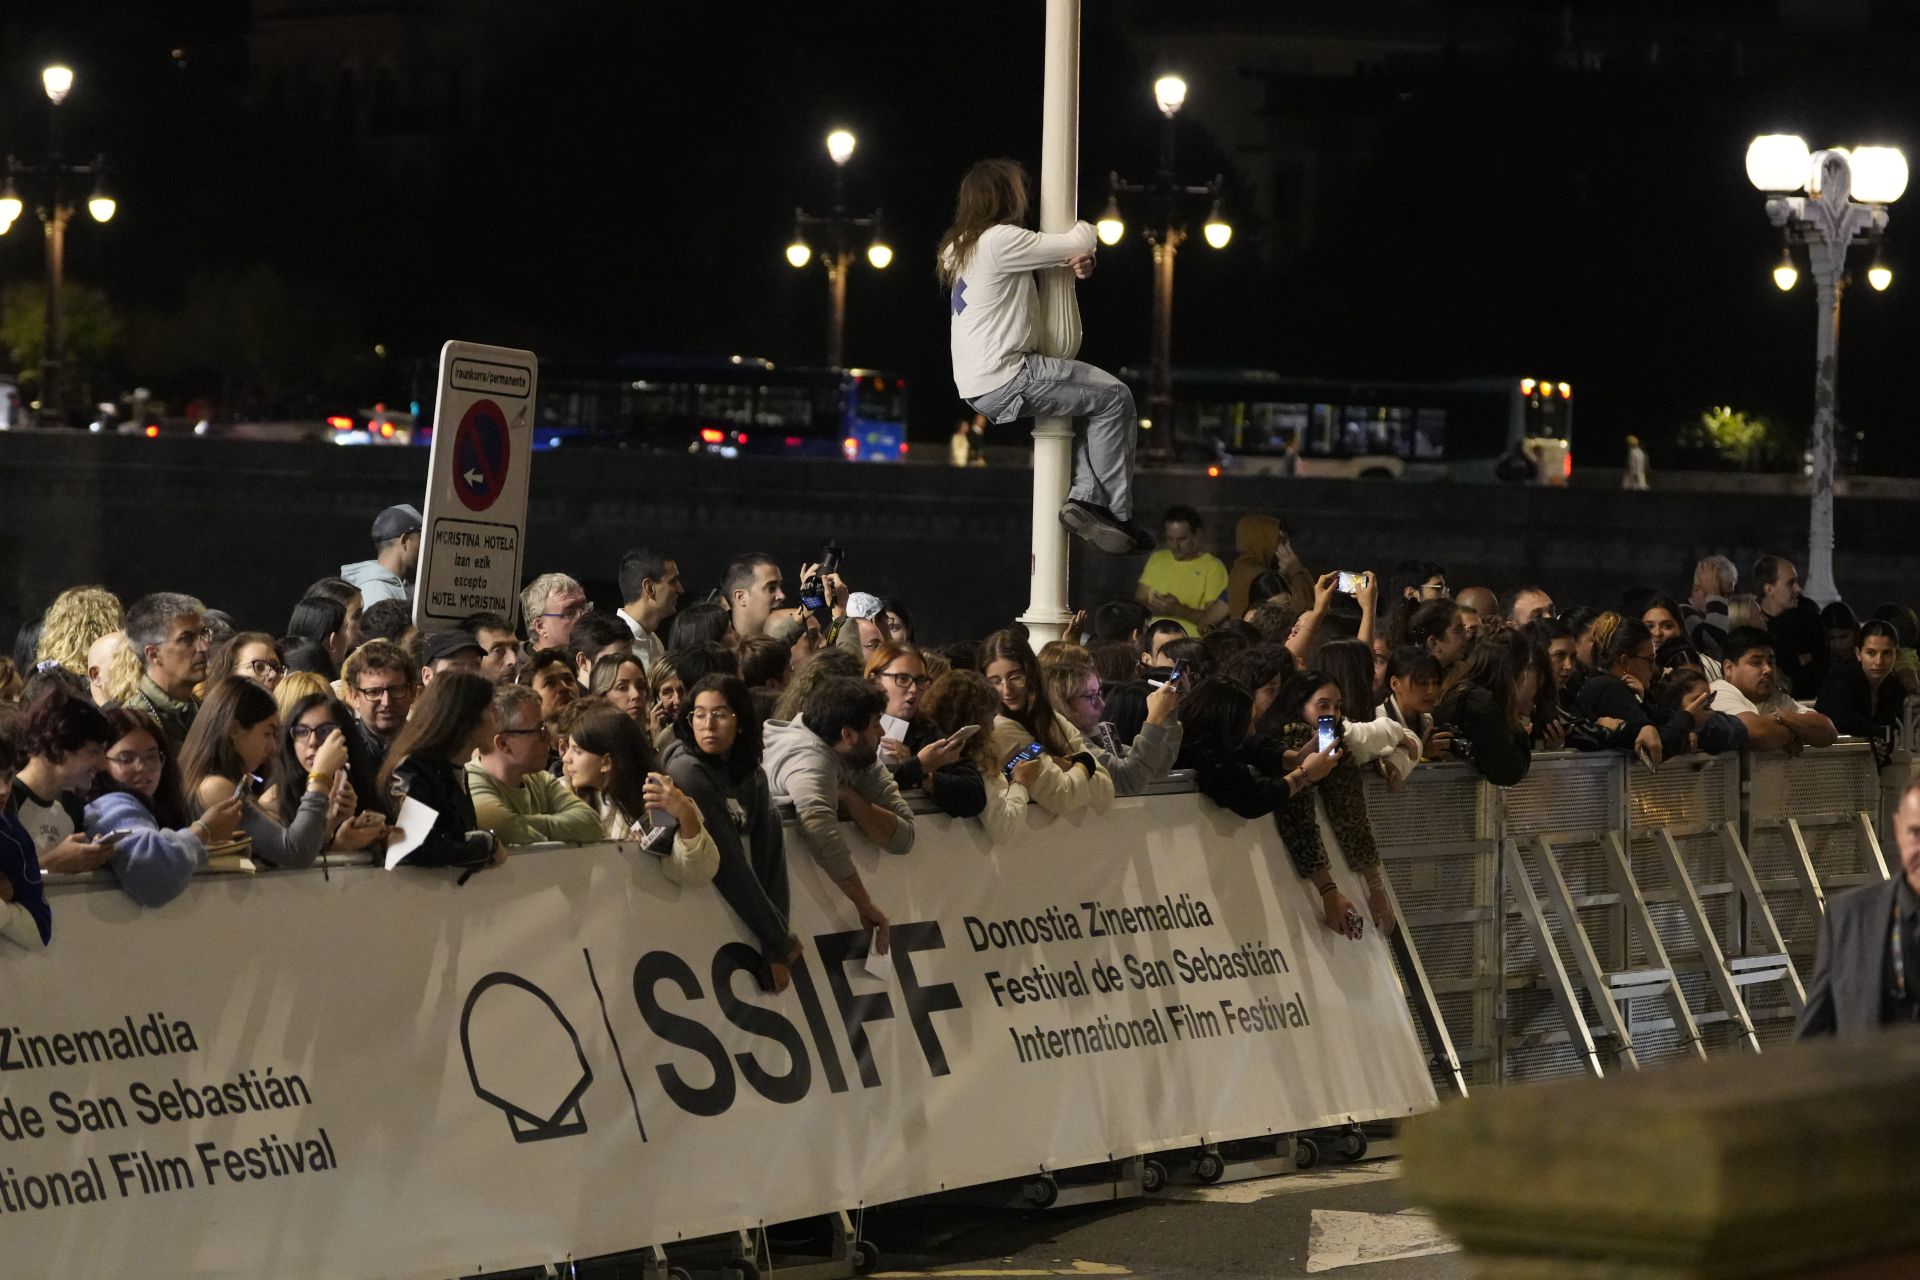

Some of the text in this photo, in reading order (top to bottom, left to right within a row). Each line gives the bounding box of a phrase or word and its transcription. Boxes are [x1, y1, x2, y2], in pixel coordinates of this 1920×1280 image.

[454, 553, 491, 569] izan ezik
[484, 535, 514, 551] HOTELA
[432, 592, 456, 607] HOTEL
[454, 576, 487, 591] excepto
[964, 893, 1214, 952] Donostia Zinemaldia
[985, 941, 1290, 1007] Festival de San Sebastián
[0, 1012, 199, 1071] Zinemaldia
[633, 920, 963, 1117] SSIFF
[1009, 992, 1310, 1063] International Film Festival
[0, 1067, 312, 1141] de San Sebastián
[108, 1151, 194, 1197] Film
[195, 1128, 338, 1185] Festival
